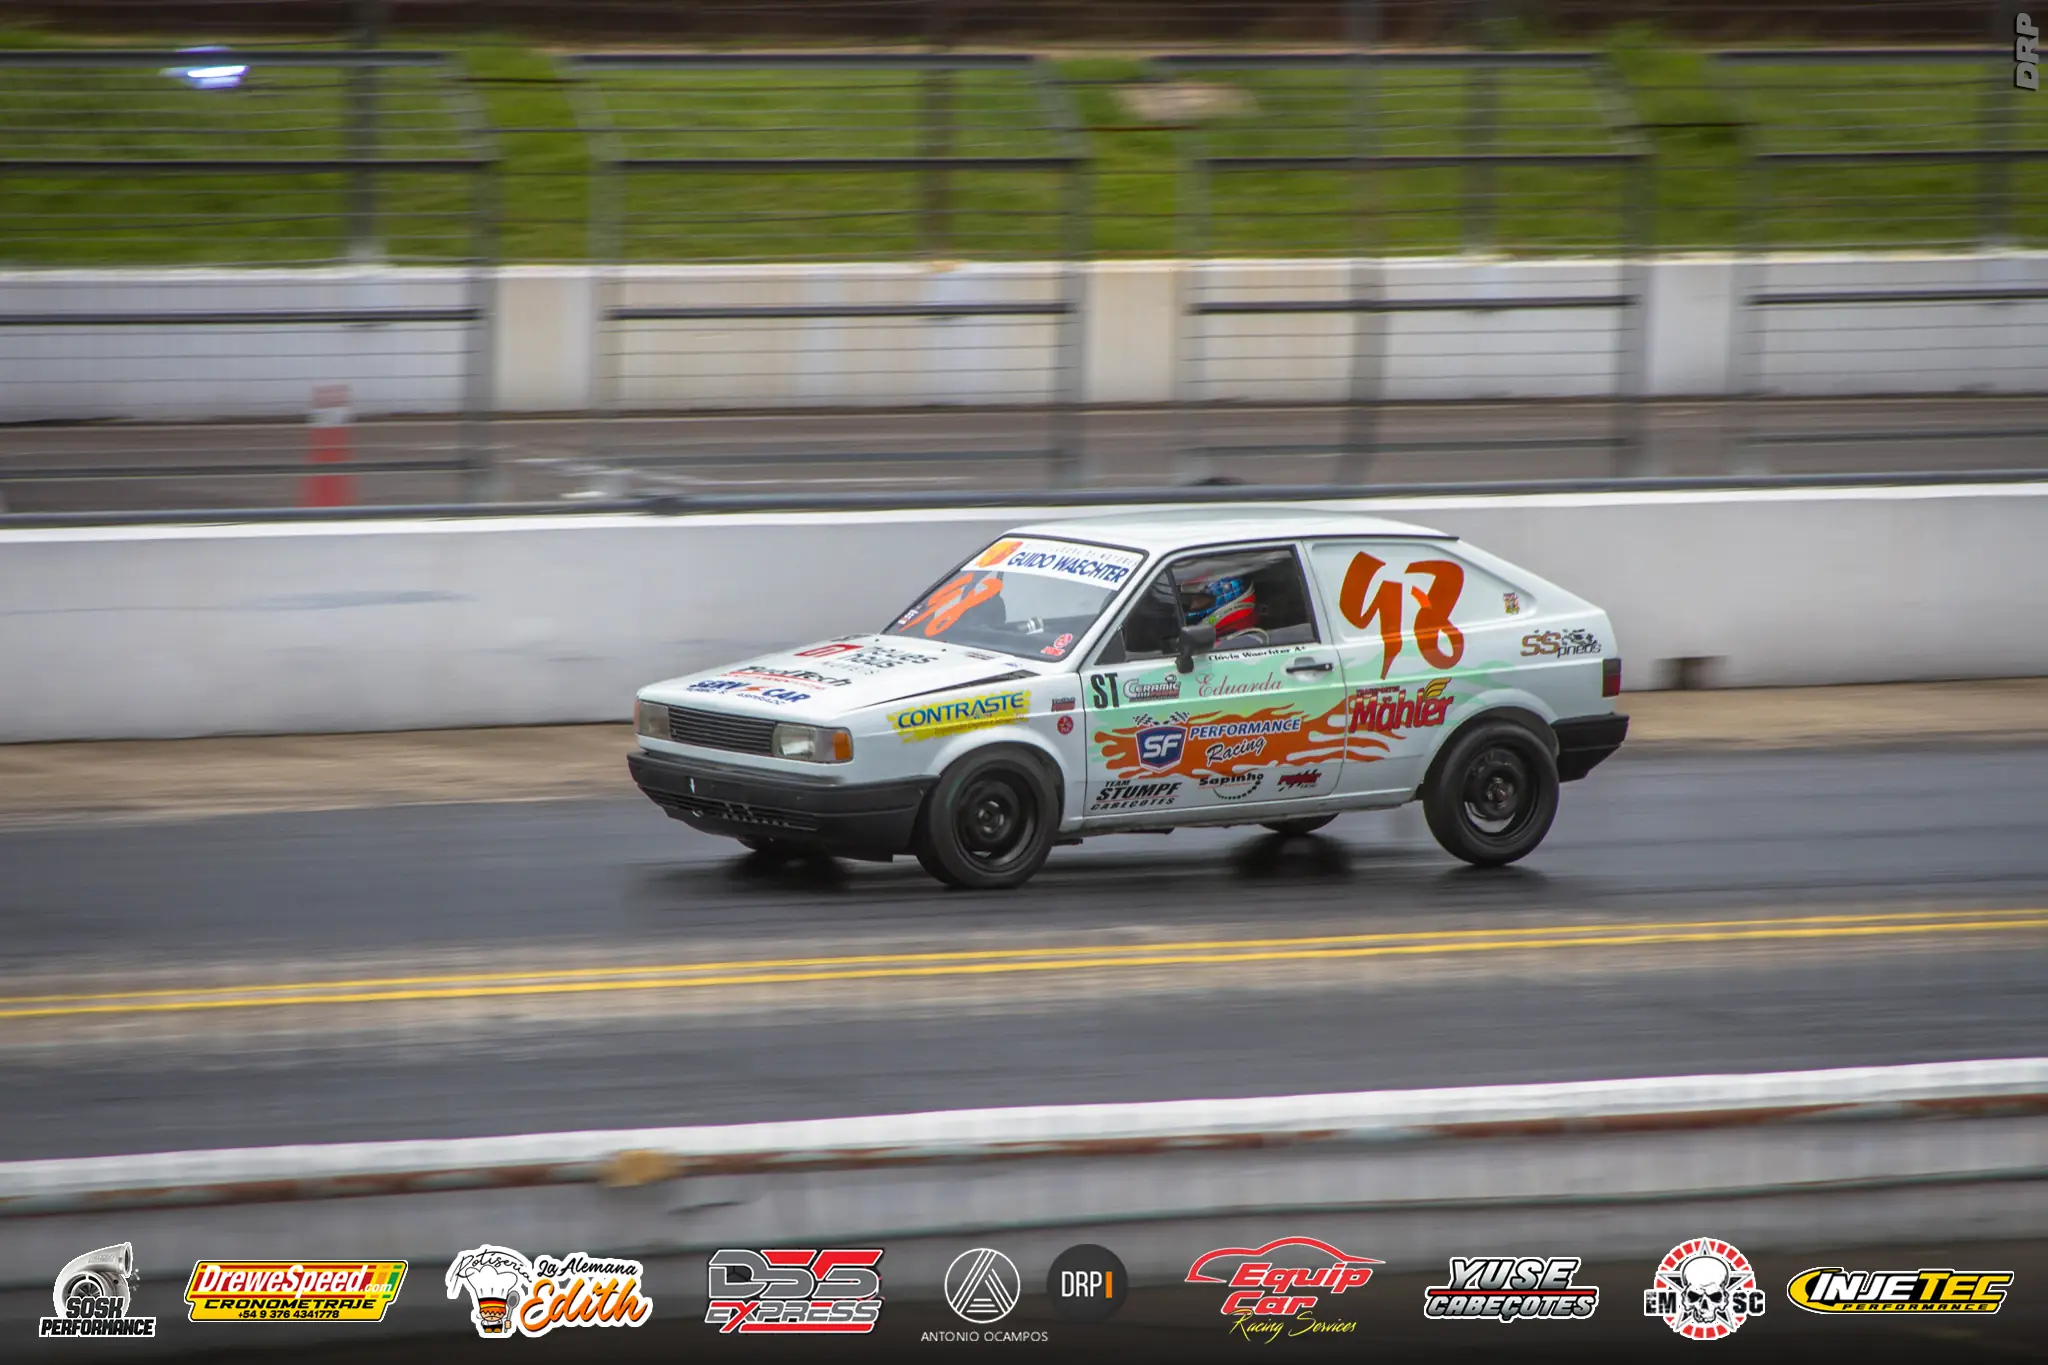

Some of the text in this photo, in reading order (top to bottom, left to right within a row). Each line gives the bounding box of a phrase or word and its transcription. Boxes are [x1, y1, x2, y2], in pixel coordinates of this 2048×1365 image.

[1007, 551, 1130, 583] GUIDO WAECHTER
[1090, 672, 1120, 709] ST
[1195, 671, 1283, 698] Eduarda
[897, 692, 1024, 729] CONTRASTE
[1348, 687, 1454, 733] Mähler
[1189, 718, 1302, 741] PERFORMANCE
[1142, 732, 1183, 759] SF
[1206, 736, 1268, 767] Racing
[1096, 781, 1183, 801] STUMPF
[1105, 779, 1131, 788] TEAM
[1199, 771, 1265, 786] Sapinho
